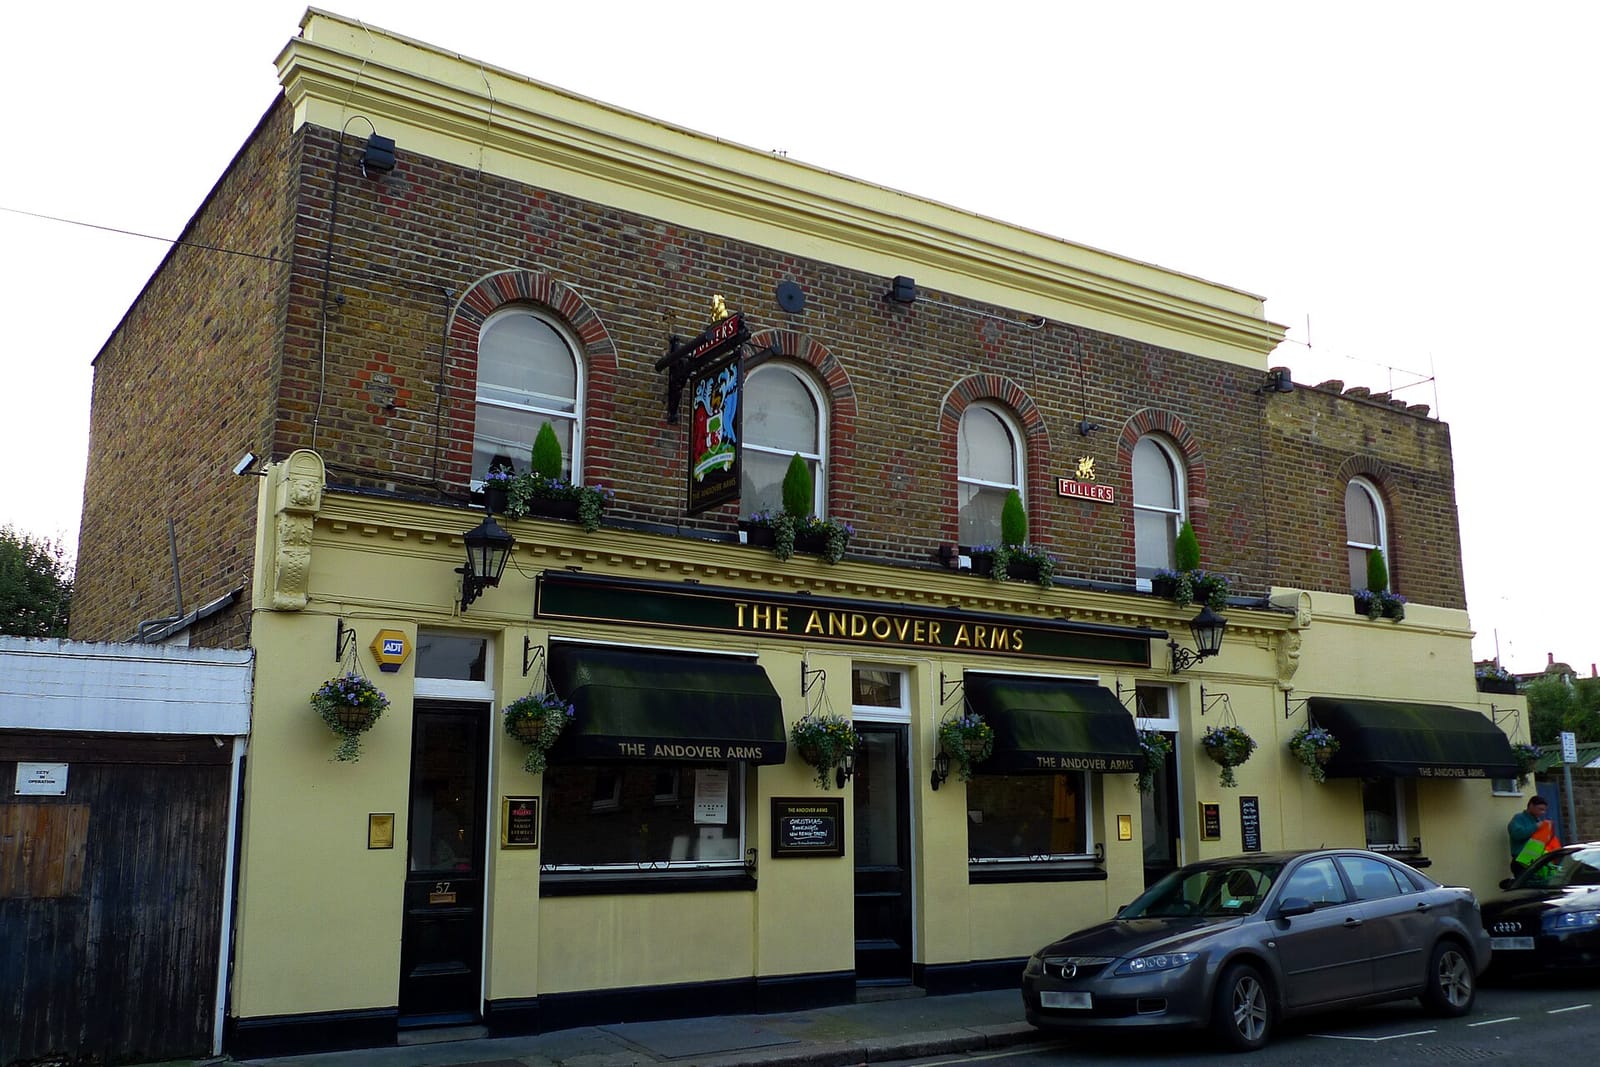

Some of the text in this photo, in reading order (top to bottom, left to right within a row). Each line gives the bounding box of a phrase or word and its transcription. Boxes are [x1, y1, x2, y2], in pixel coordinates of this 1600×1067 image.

[734, 603, 1024, 651] THE ANDOVER ARMS
[383, 642, 403, 652] ADT
[618, 743, 763, 759] THE ANDOVER ARMS
[1036, 756, 1134, 770] THE ANDOVER ARMS
[1418, 767, 1432, 777] THE
[435, 882, 450, 894] 57
